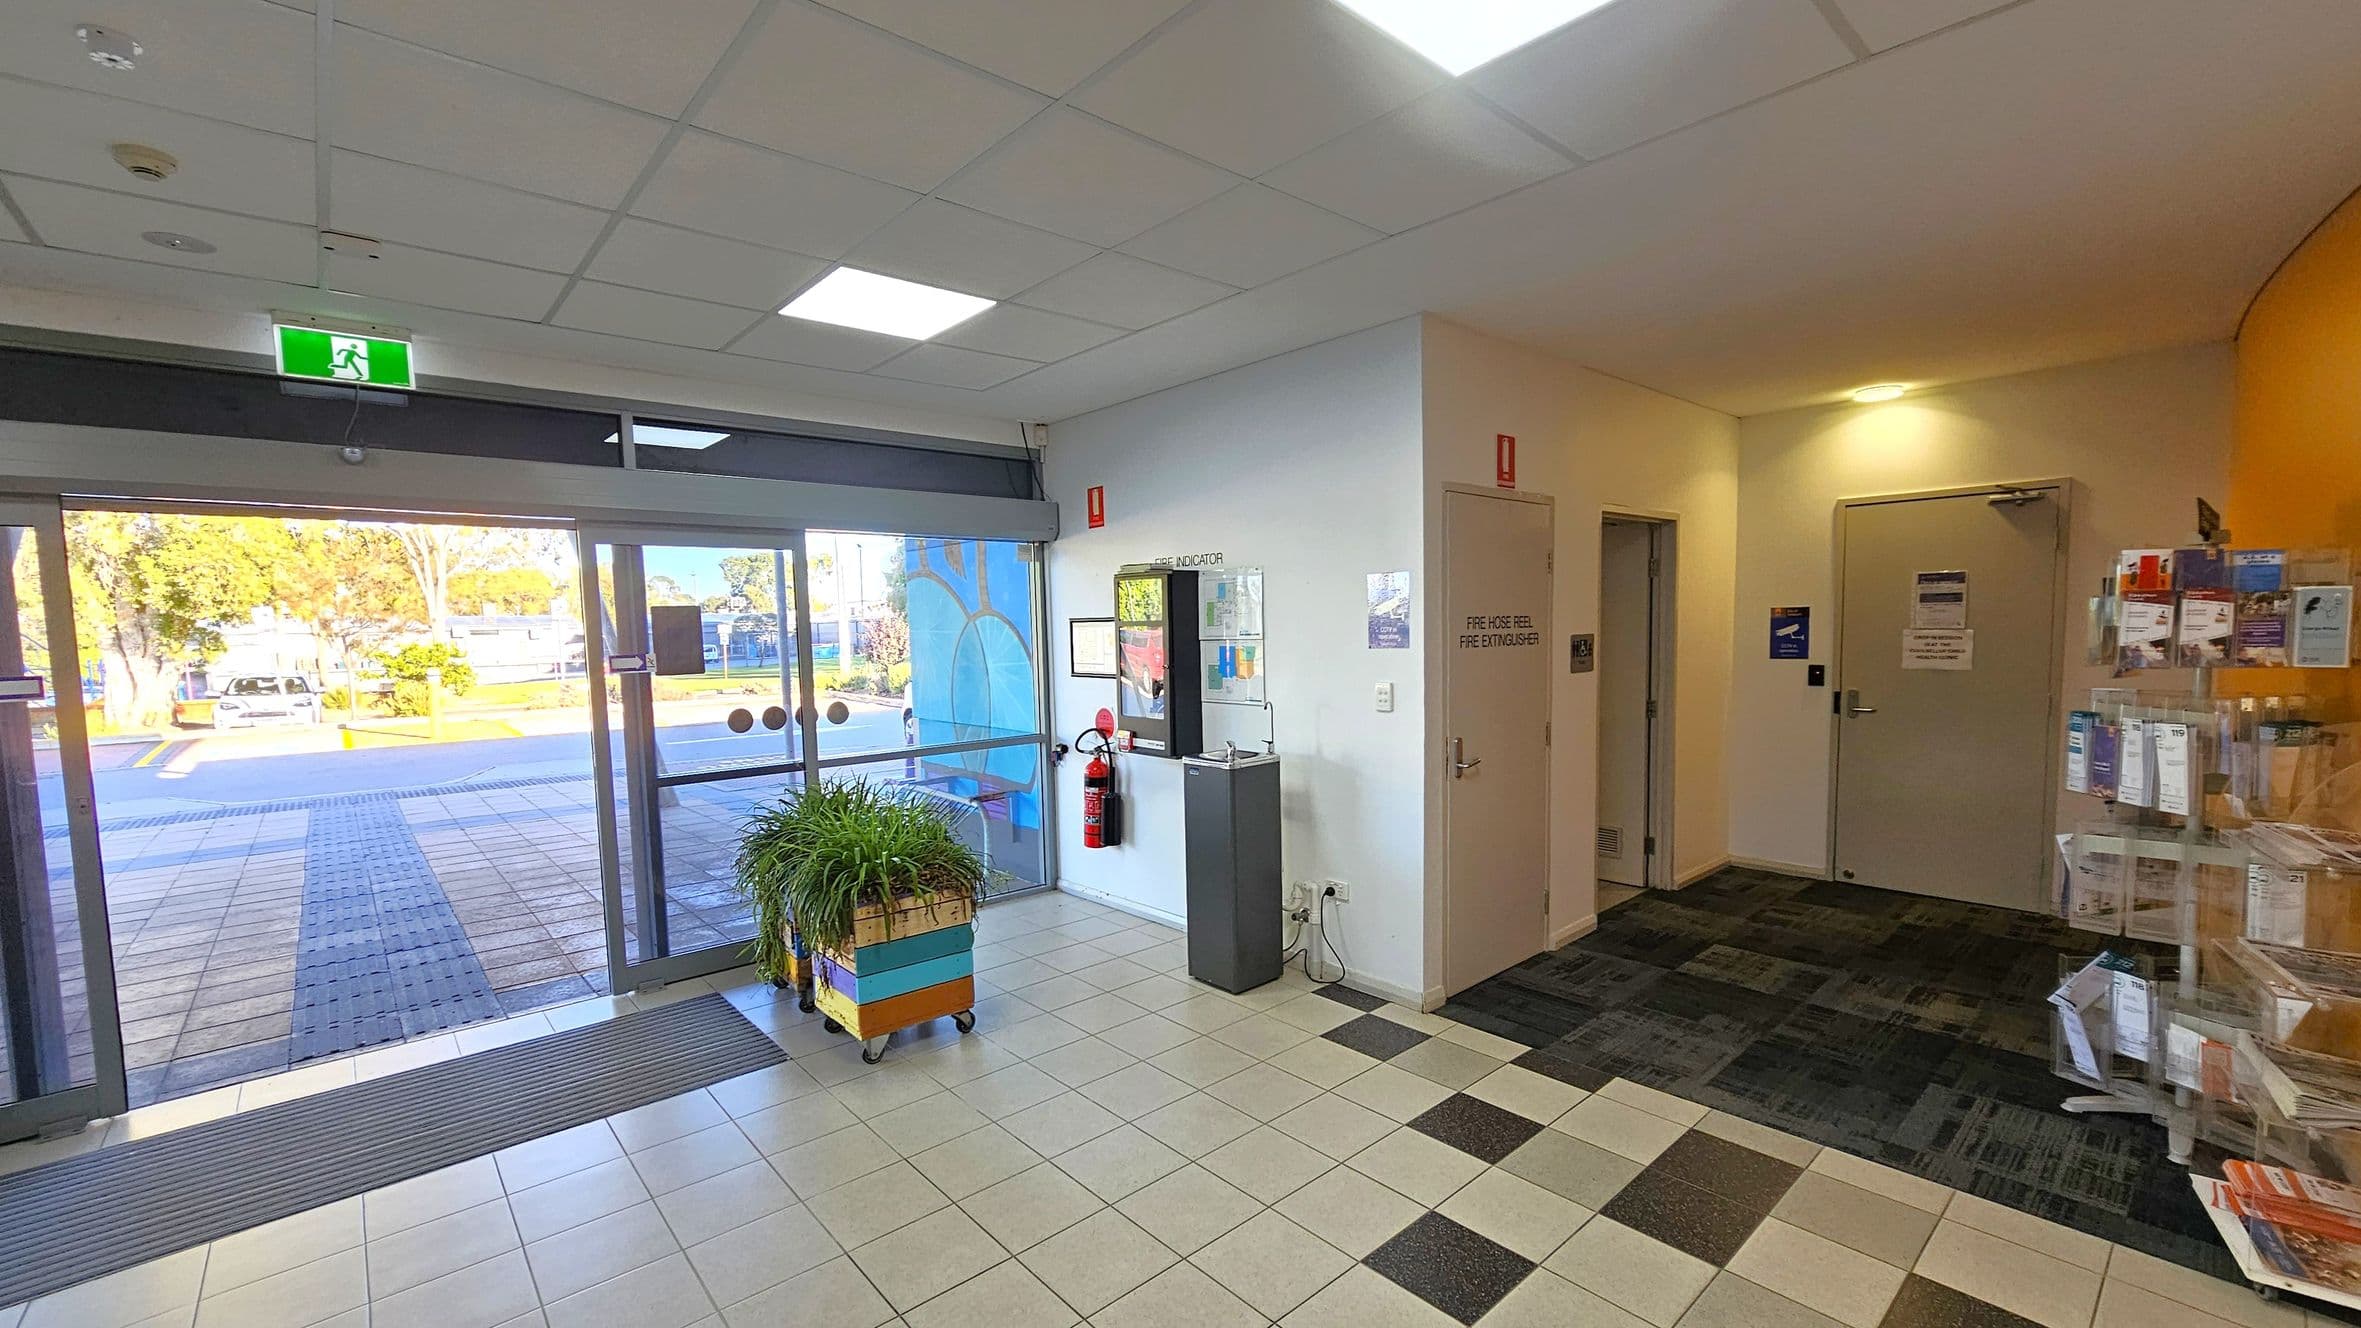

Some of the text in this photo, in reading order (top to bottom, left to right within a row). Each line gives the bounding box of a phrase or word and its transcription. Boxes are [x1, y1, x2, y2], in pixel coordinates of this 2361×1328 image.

[1176, 552, 1223, 567] INDICATOR
[1467, 615, 1533, 629] FIRE HOSE REEL
[1460, 632, 1539, 648] FIRE EXTINGUISHER
[2171, 729, 2185, 737] 119
